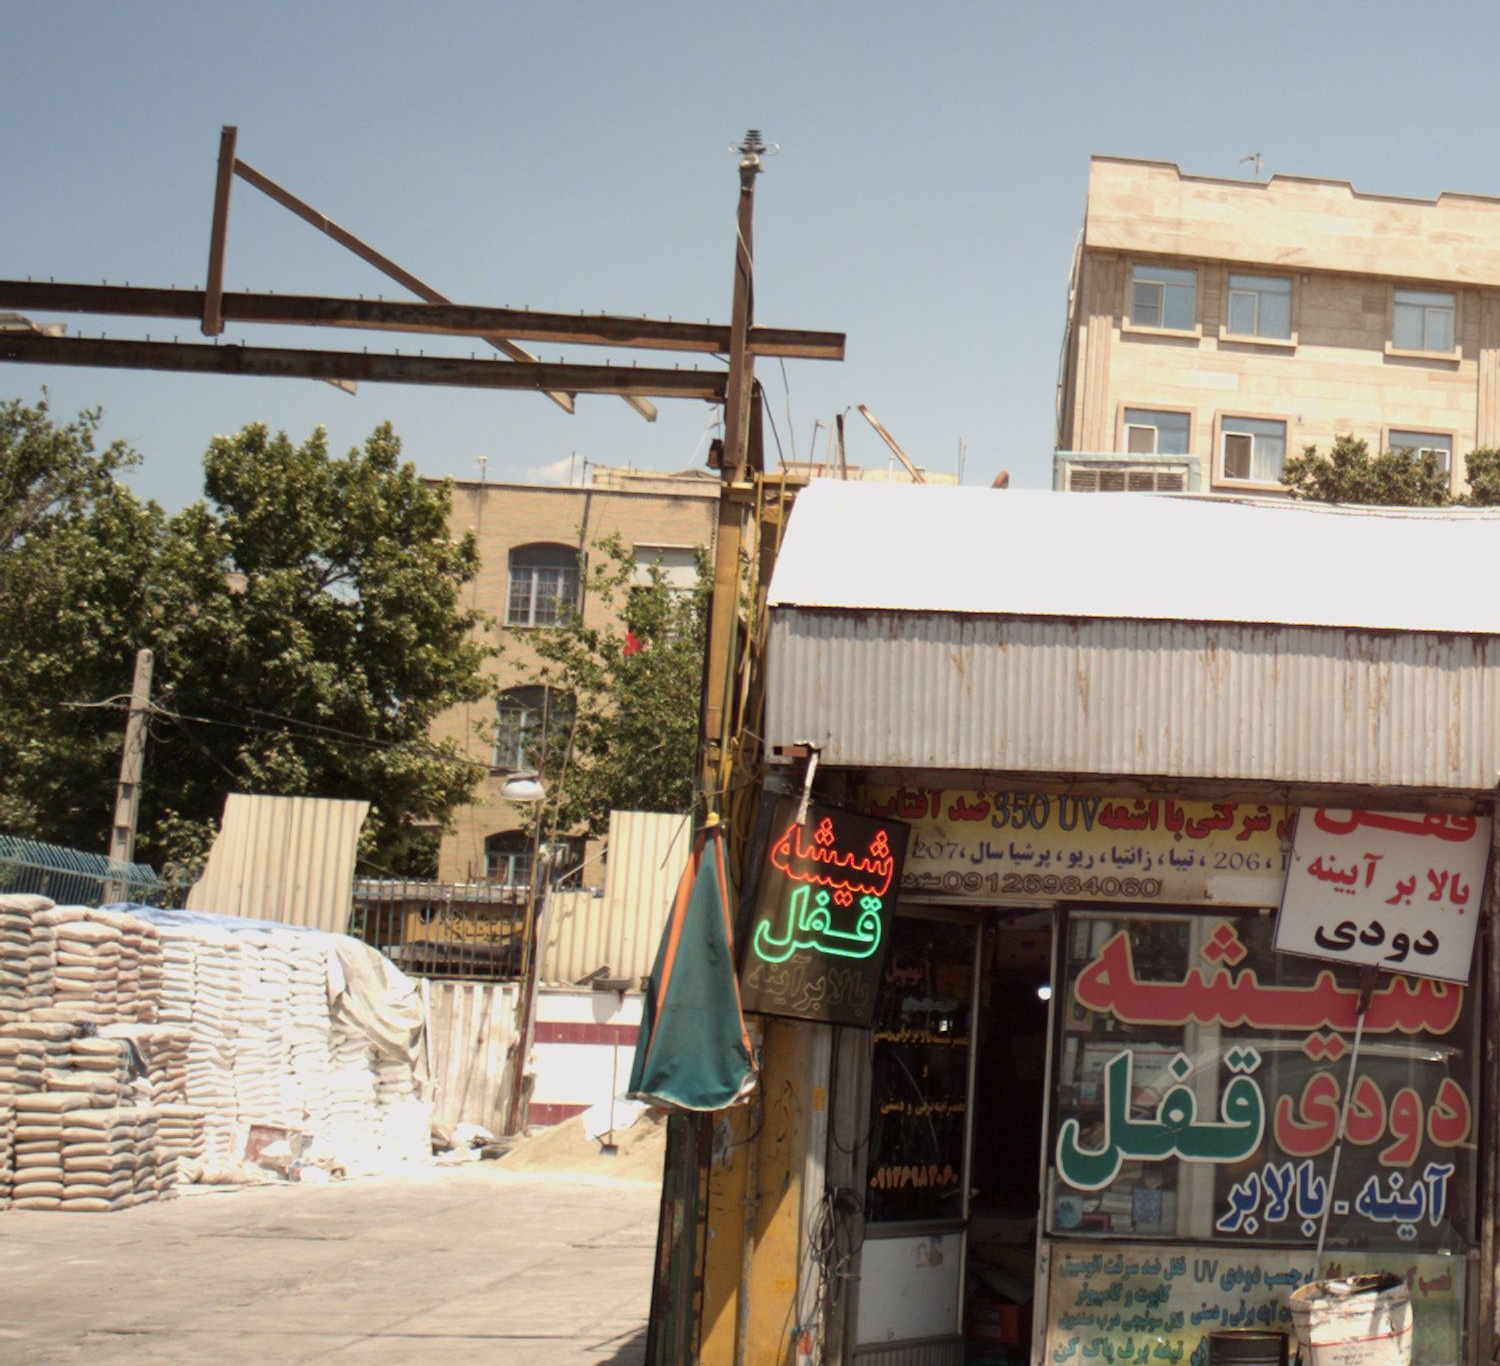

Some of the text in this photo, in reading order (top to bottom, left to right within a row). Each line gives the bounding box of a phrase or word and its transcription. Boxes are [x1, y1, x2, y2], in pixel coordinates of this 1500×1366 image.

[948, 790, 991, 821] ضد
[991, 790, 1050, 830] 350
[1058, 793, 1101, 831] UV
[1098, 798, 1159, 831] اشعه
[1165, 801, 1184, 841] با
[771, 817, 893, 907] شیشه
[911, 842, 959, 859] 207
[1009, 843, 1051, 869] پرشیا
[945, 871, 1162, 897] 09126984060
[1307, 853, 1384, 895] آیینه
[754, 885, 882, 963] قفل
[1314, 920, 1440, 963] دودی
[1056, 1046, 1471, 1191] دودی قفل
[1356, 1162, 1455, 1239] آینه
[1104, 1254, 1139, 1280] سرقت
[1141, 1257, 1161, 1276] ضد
[1163, 1255, 1187, 1280] قفل
[1194, 1260, 1219, 1283] UV
[1220, 1265, 1261, 1292] دودی
[1054, 1337, 1080, 1363] کن
[1082, 1337, 1115, 1365] پاک
[1117, 1337, 1150, 1365] برف
